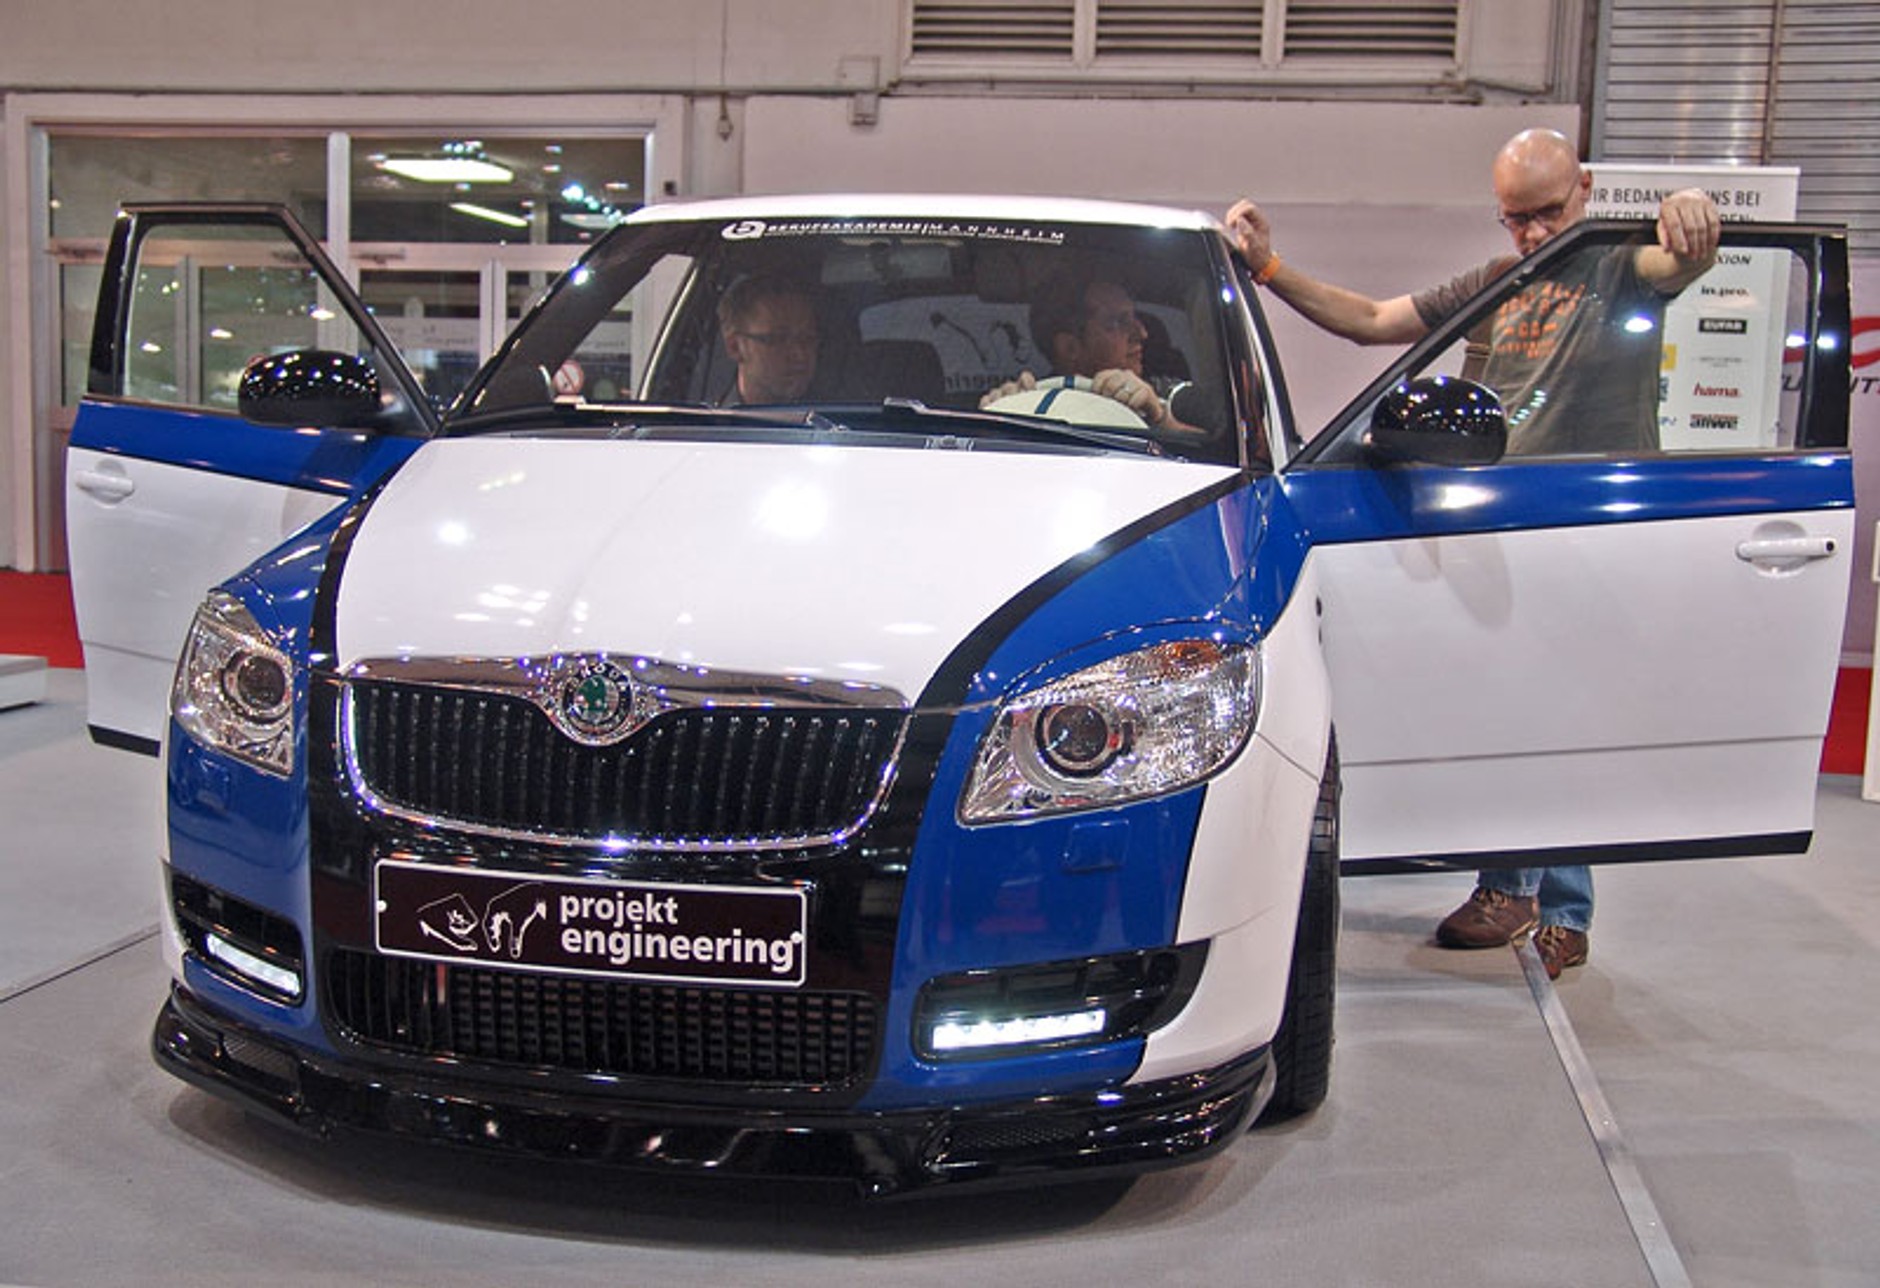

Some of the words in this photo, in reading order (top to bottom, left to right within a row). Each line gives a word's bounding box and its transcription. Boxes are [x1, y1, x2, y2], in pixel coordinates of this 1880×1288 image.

[1593, 188, 1608, 204] IR
[1613, 188, 1664, 205] BEDAN
[1735, 190, 1760, 207] BEI
[560, 891, 678, 927] projekt
[561, 923, 794, 973] engineering
